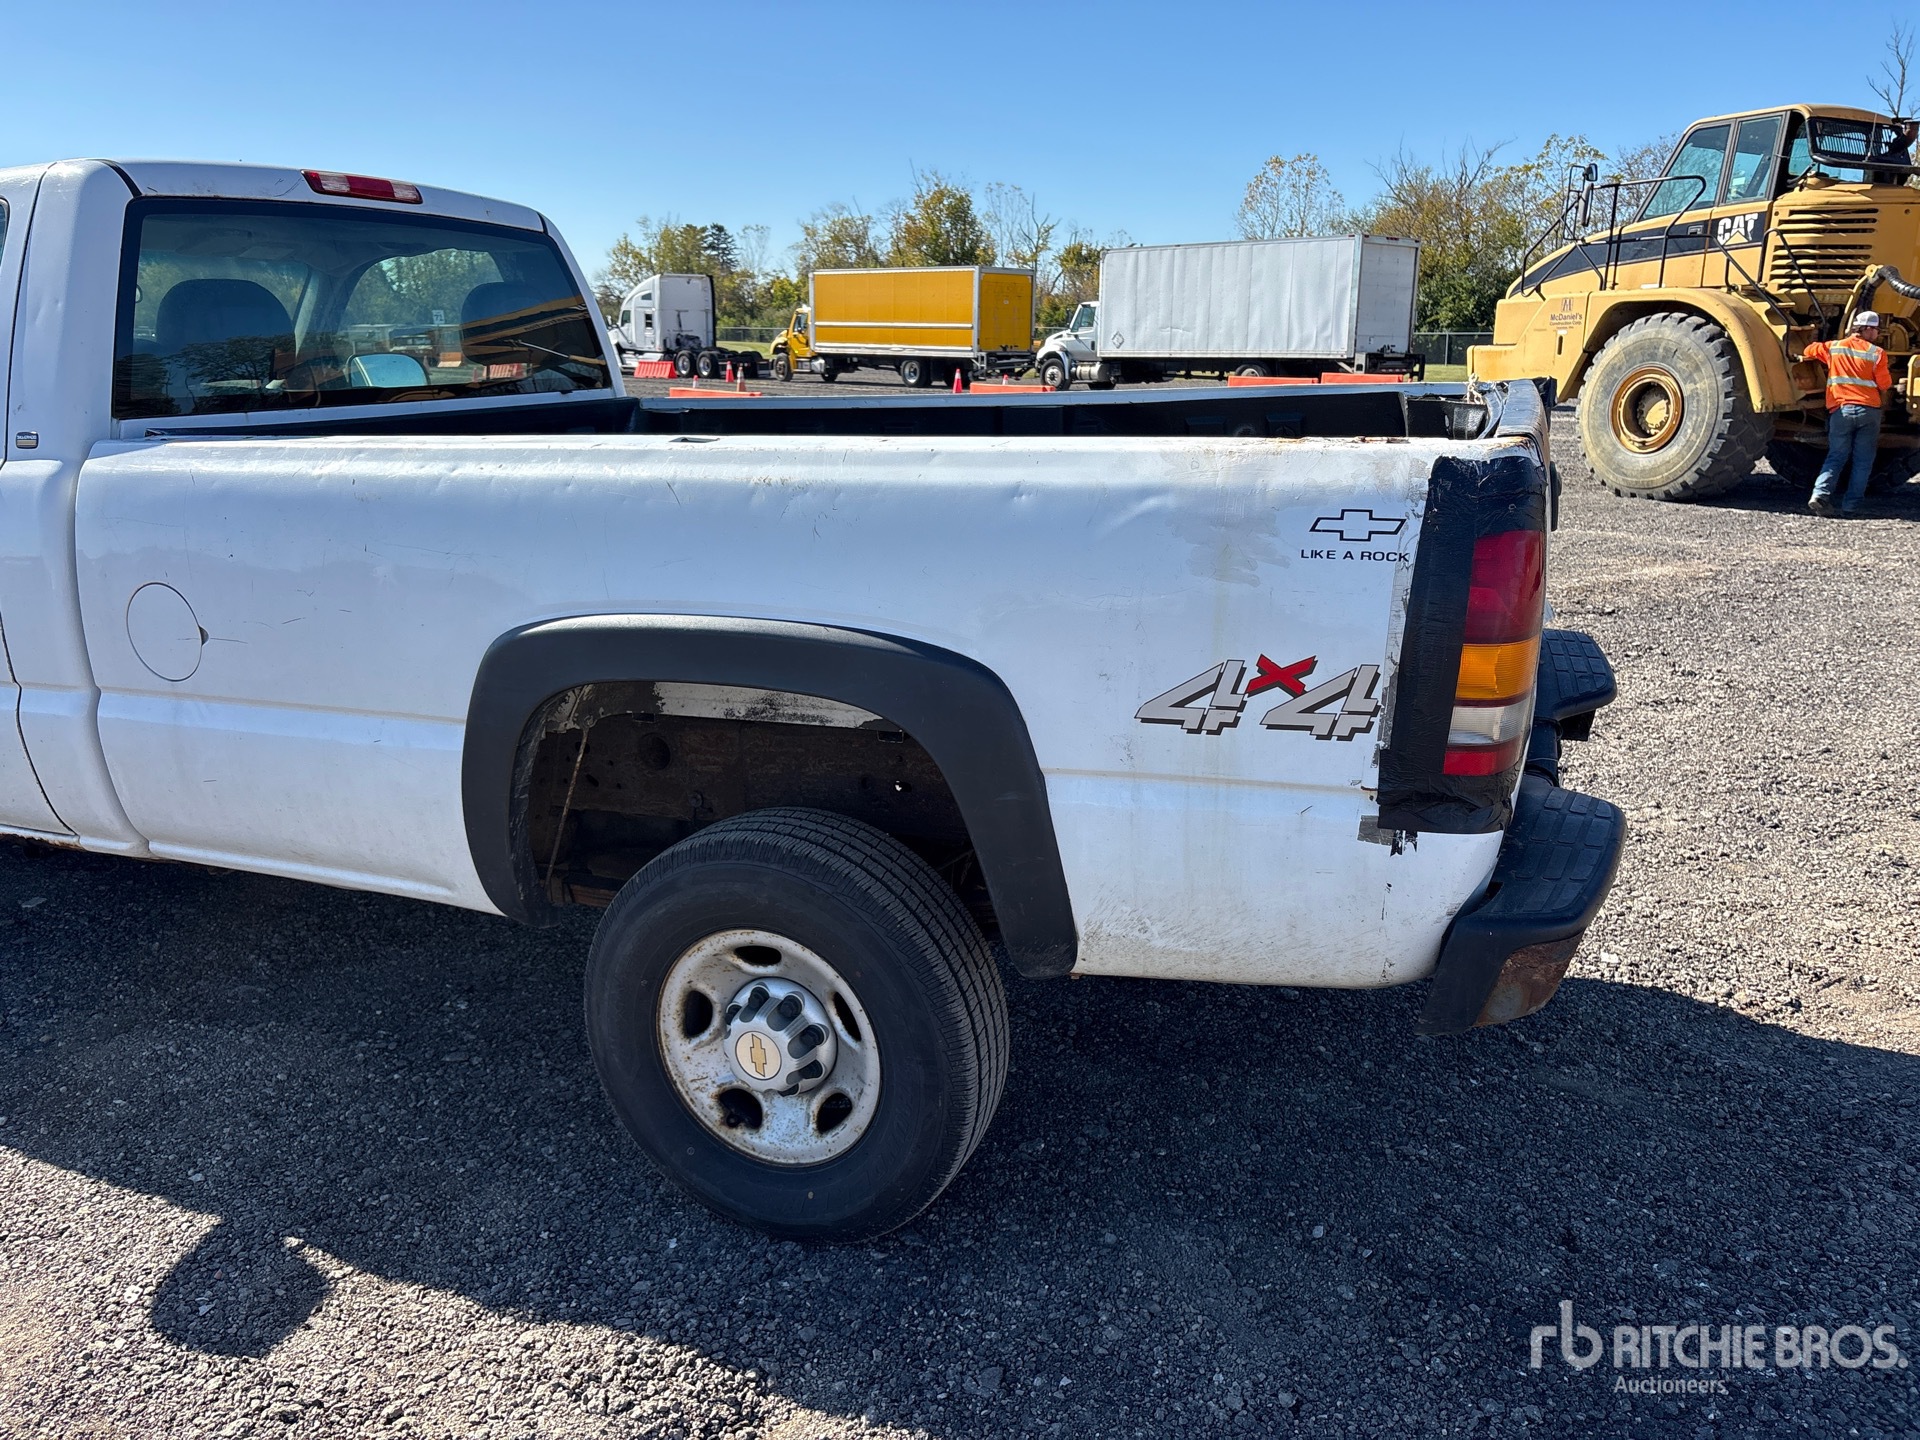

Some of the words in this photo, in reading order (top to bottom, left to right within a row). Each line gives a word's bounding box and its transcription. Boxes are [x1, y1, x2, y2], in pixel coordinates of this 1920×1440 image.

[1717, 212, 1759, 246] CAT
[1550, 312, 1583, 321] McDaniel's
[1300, 549, 1337, 560] LIKE
[1342, 550, 1355, 561] A
[1360, 551, 1411, 563] ROCK
